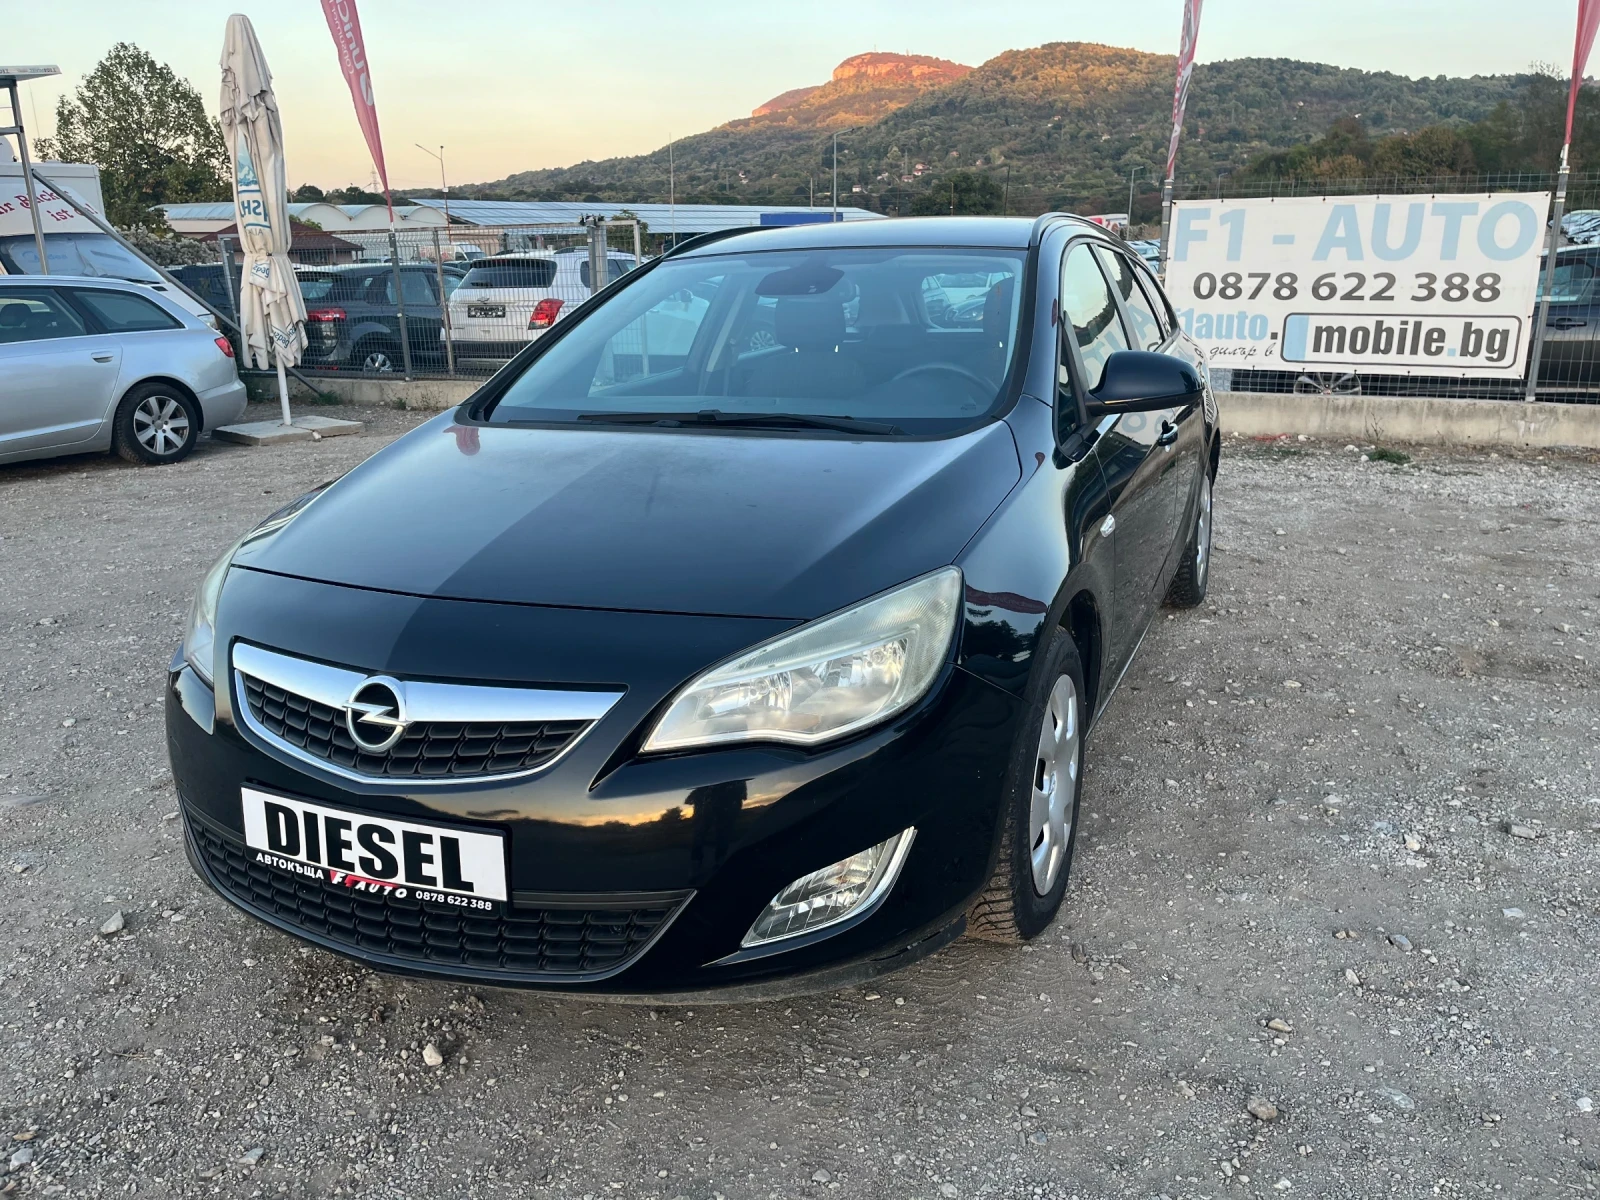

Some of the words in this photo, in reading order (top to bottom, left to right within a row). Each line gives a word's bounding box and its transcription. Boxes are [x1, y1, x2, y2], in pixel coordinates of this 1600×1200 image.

[1173, 207, 1246, 262] F1
[1312, 200, 1538, 262] AUTO
[1193, 272, 1298, 300] 0878
[1311, 272, 1396, 301] 622
[1410, 272, 1501, 302] 388
[1312, 320, 1509, 362] mobile.bg
[263, 800, 475, 893] DIESEL
[255, 852, 324, 880] АВТОКЪЩА
[355, 882, 408, 899] AUTO
[415, 890, 445, 903] 0878
[447, 895, 467, 907] 622
[470, 899, 492, 911] 388
